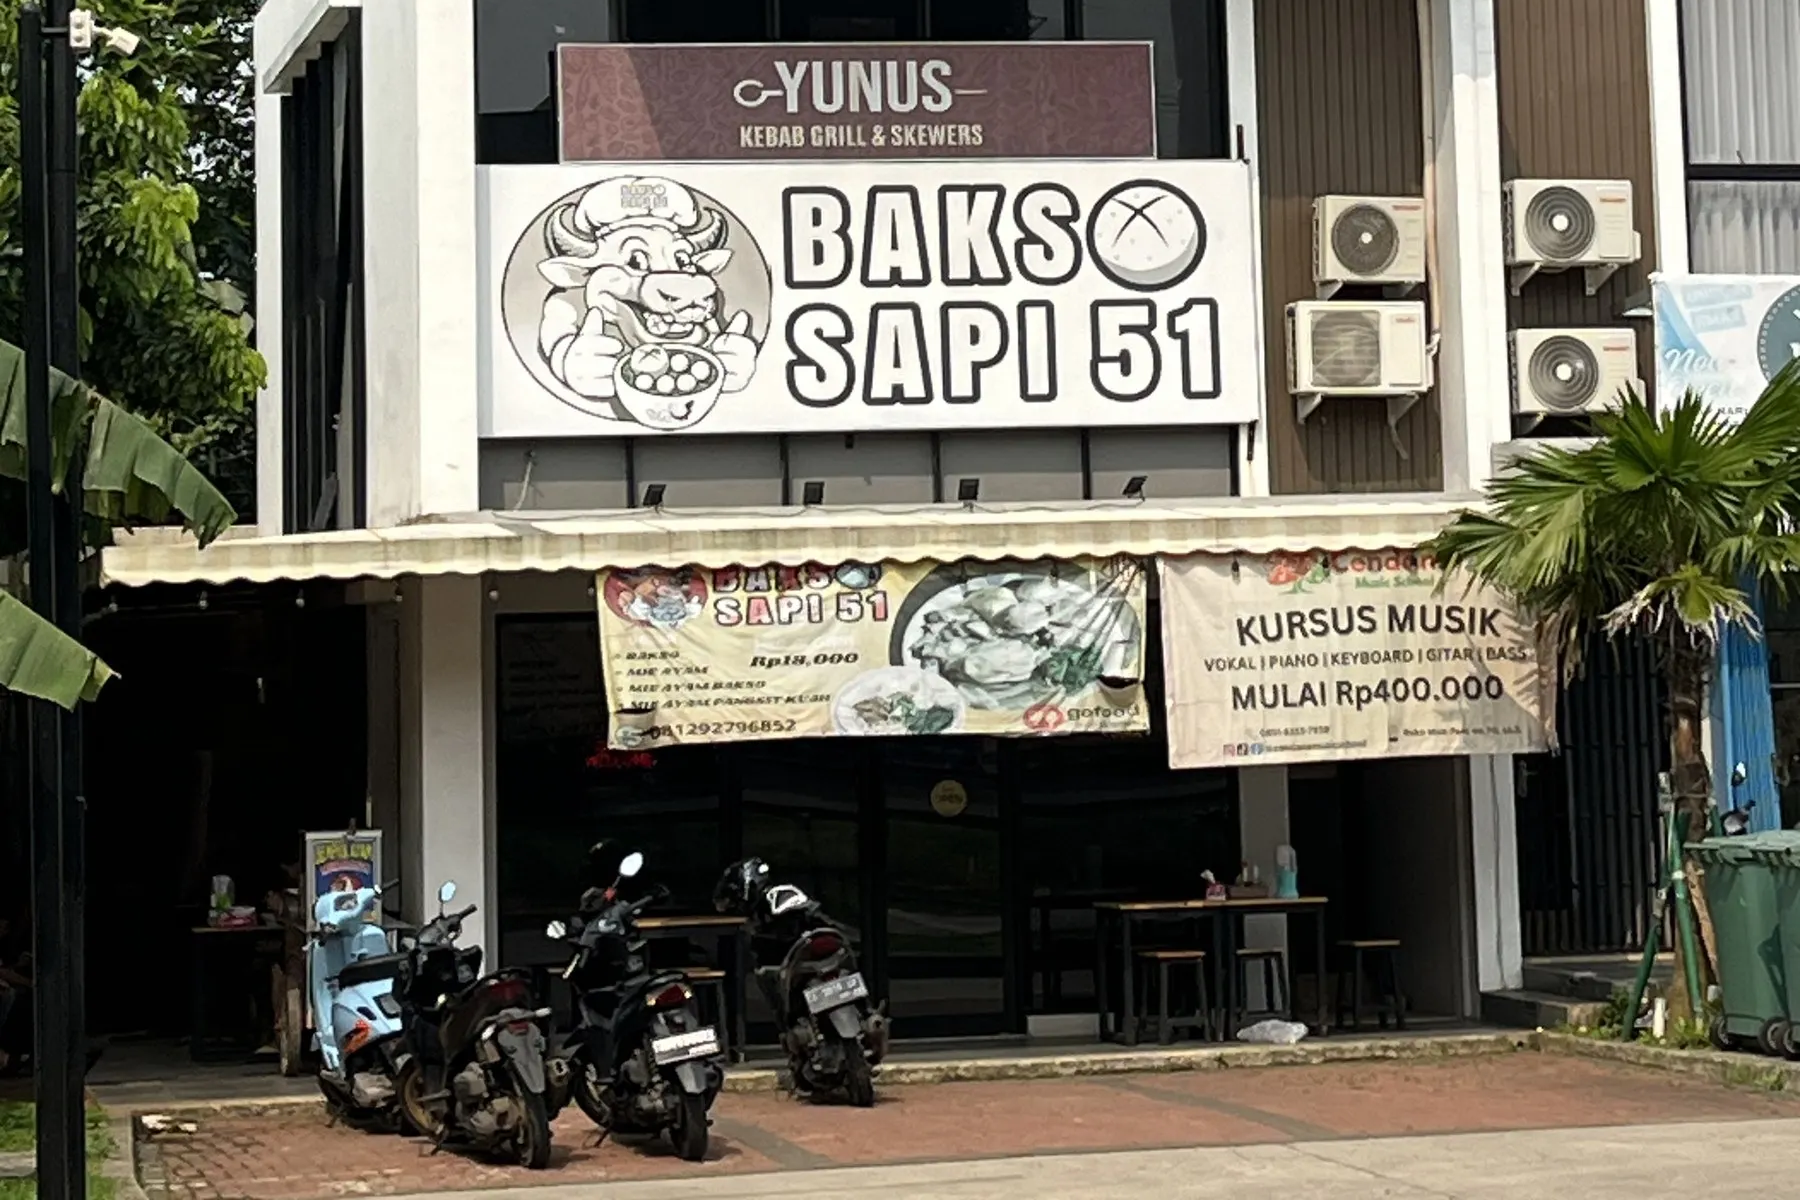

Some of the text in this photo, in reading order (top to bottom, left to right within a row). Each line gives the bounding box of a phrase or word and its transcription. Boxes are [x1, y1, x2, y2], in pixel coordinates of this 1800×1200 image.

[774, 60, 953, 115] YUNUS
[740, 123, 983, 148] KEBAB GRILL & SKEWERS
[785, 297, 1223, 408] SAPI 51
[714, 591, 888, 626] SAPI 51
[1236, 604, 1501, 646] KURSUS MUSIK
[1204, 646, 1527, 672] VOKAL PIANO KEYBOARD GITAR BASS
[1231, 675, 1505, 711] MULAI Rp400.000
